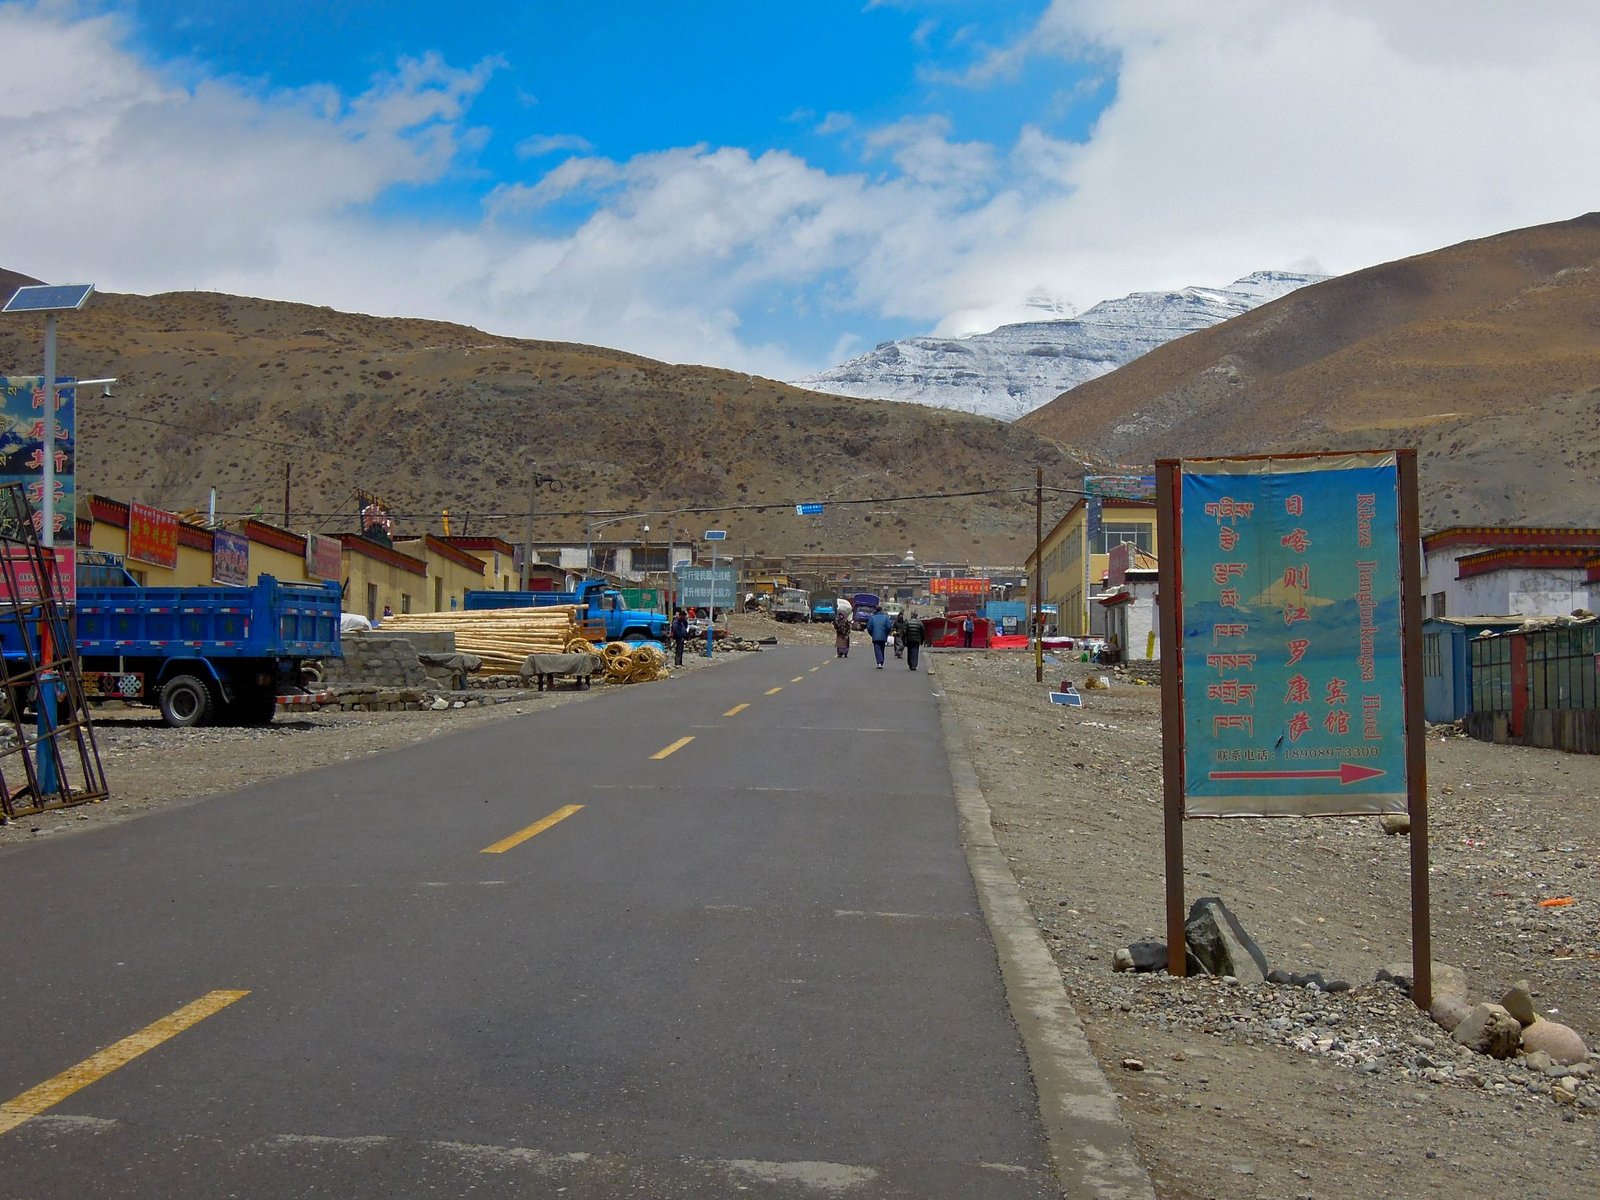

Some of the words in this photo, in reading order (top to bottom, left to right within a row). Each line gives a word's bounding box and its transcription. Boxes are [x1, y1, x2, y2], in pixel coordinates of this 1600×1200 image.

[1356, 493, 1377, 547] Rikaze
[1280, 495, 1312, 742] 日喀则江罗康萨
[1356, 560, 1379, 682] Jiangluokangsa
[1324, 678, 1349, 735] 宾馆
[1361, 695, 1383, 740] Hotel
